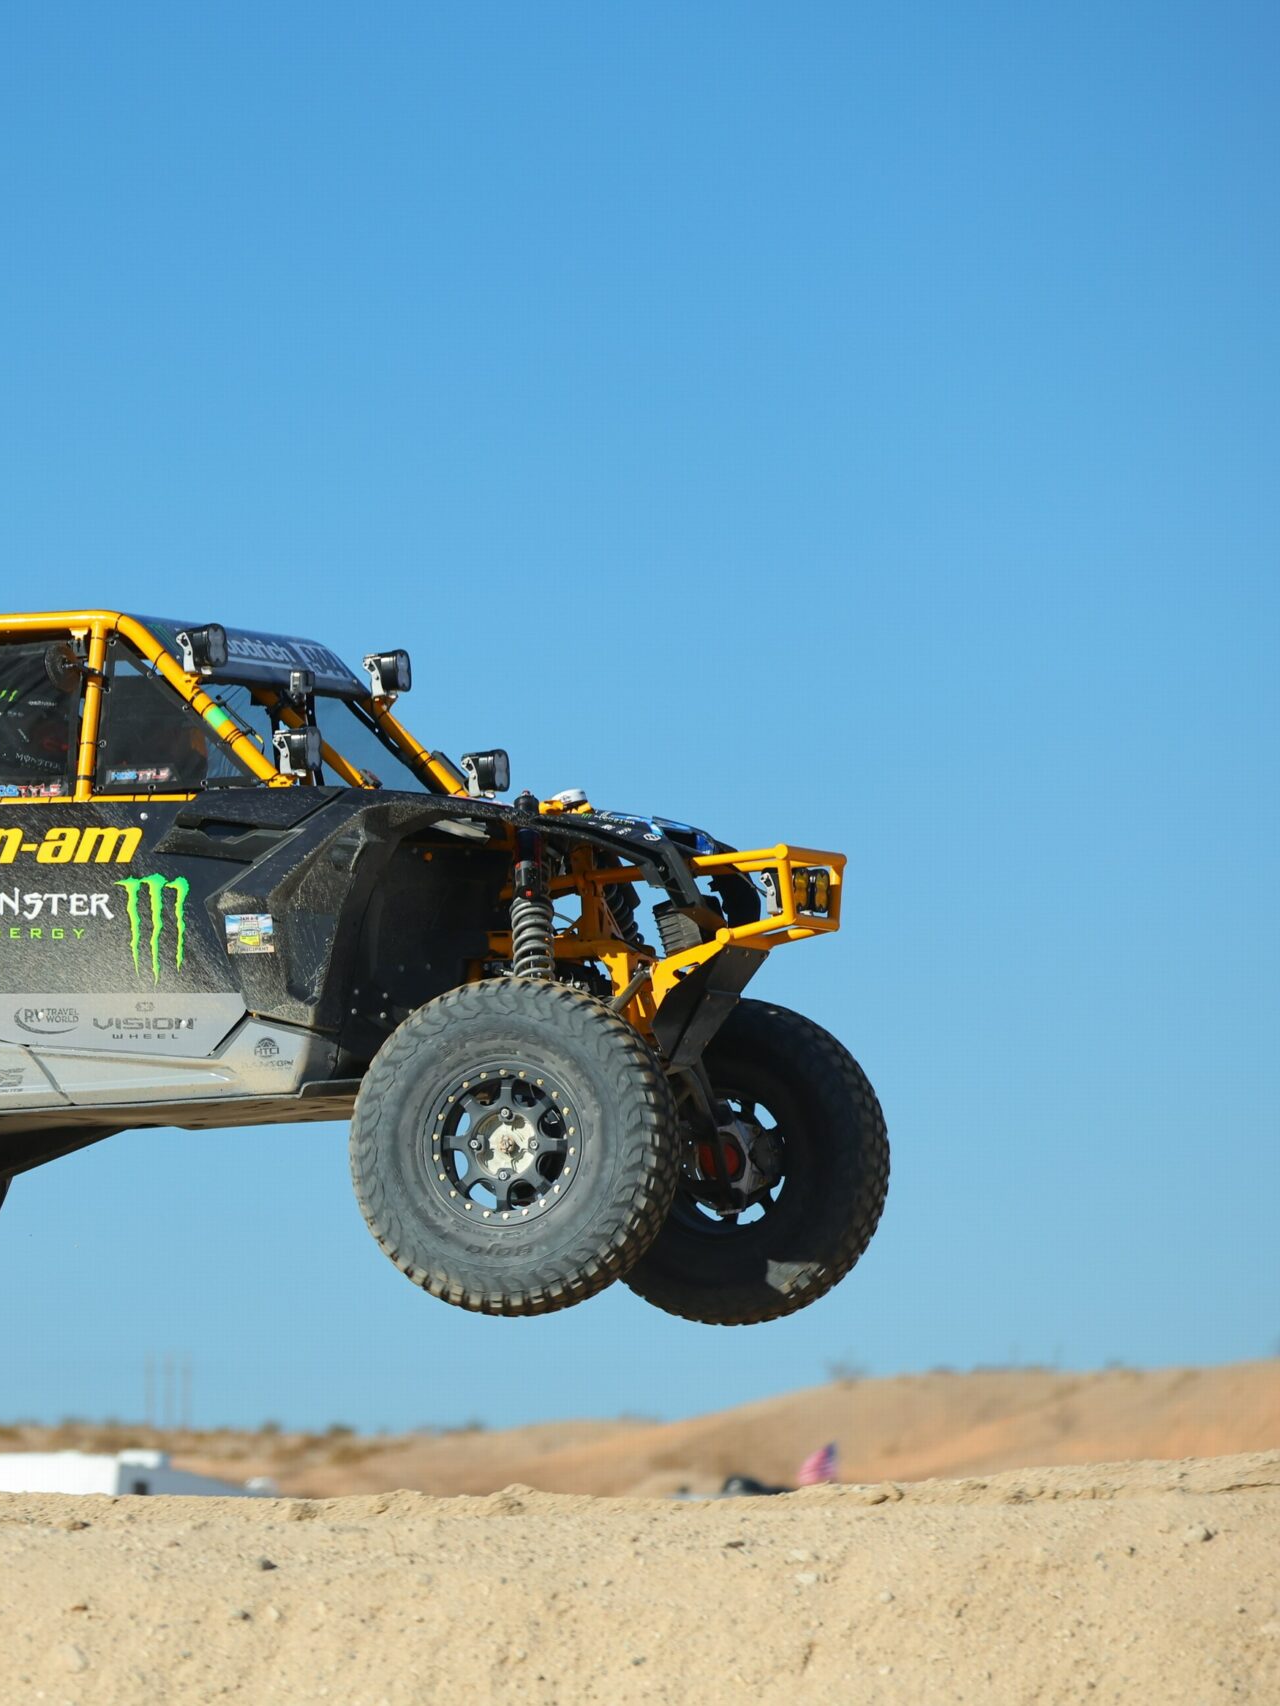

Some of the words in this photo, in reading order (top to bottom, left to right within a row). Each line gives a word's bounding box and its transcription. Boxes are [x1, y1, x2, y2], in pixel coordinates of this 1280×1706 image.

[46, 1007, 79, 1016] TRAVEL
[46, 1015, 79, 1024] WORLD
[93, 1017, 194, 1031] VISION
